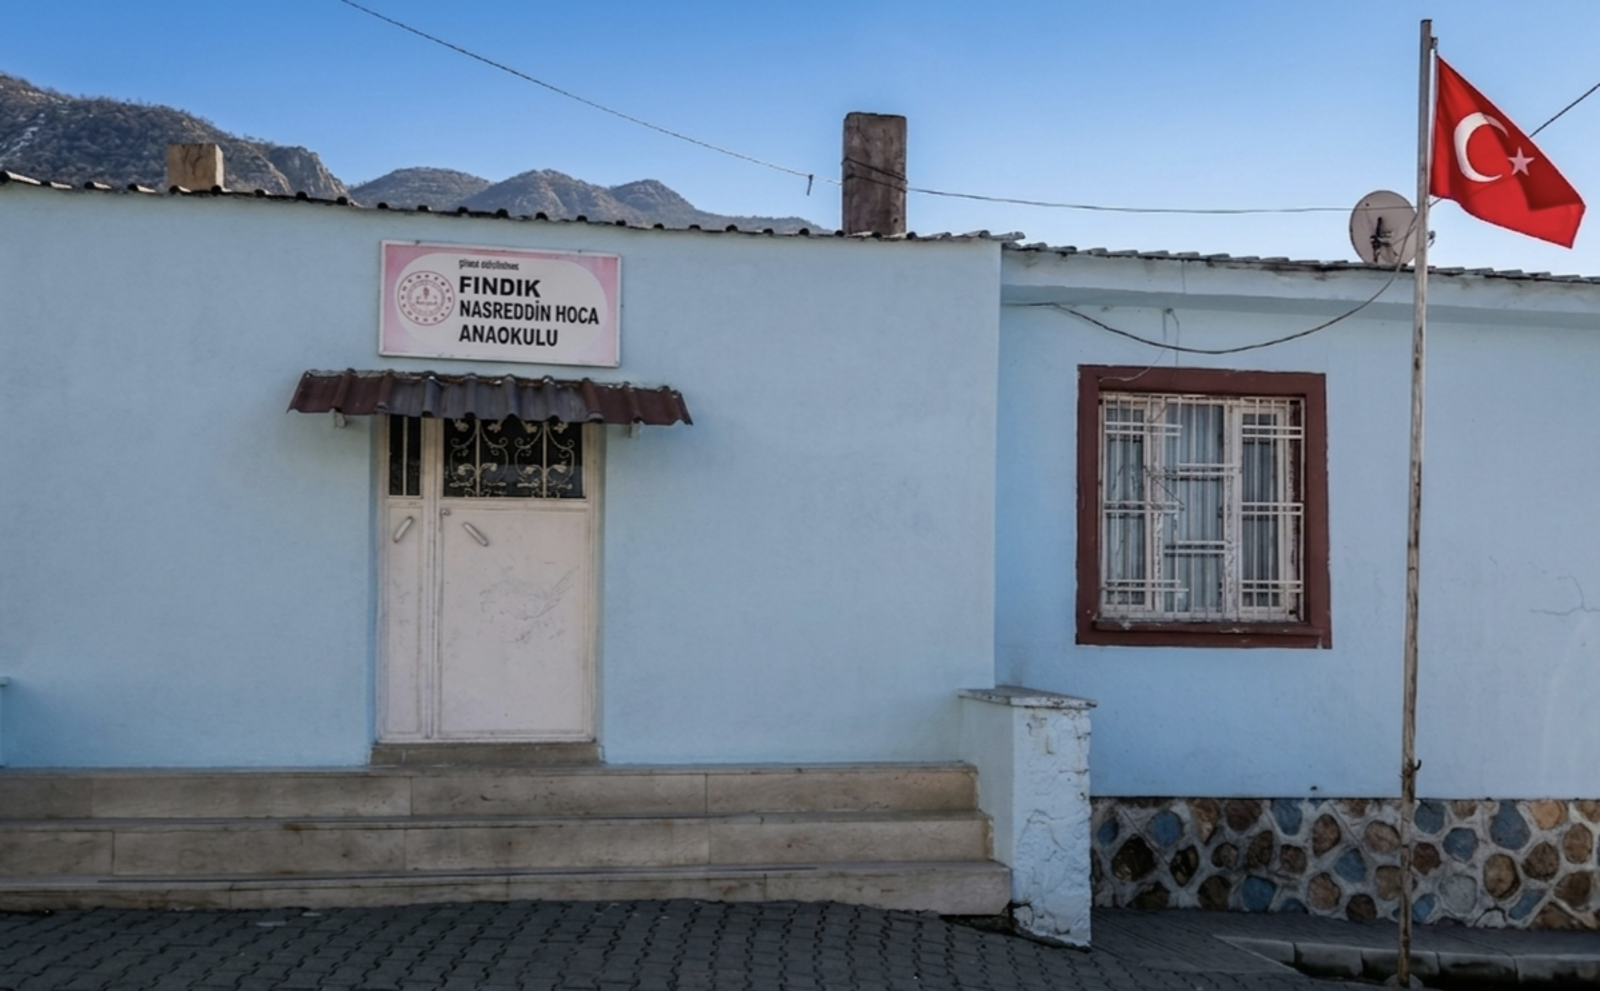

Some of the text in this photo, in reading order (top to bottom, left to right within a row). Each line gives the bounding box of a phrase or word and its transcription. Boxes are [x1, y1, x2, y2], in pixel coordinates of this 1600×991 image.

[458, 275, 541, 299] FINDIK
[459, 299, 600, 325] NASREDDİN HOCA
[458, 324, 558, 347] ANAOKULU
